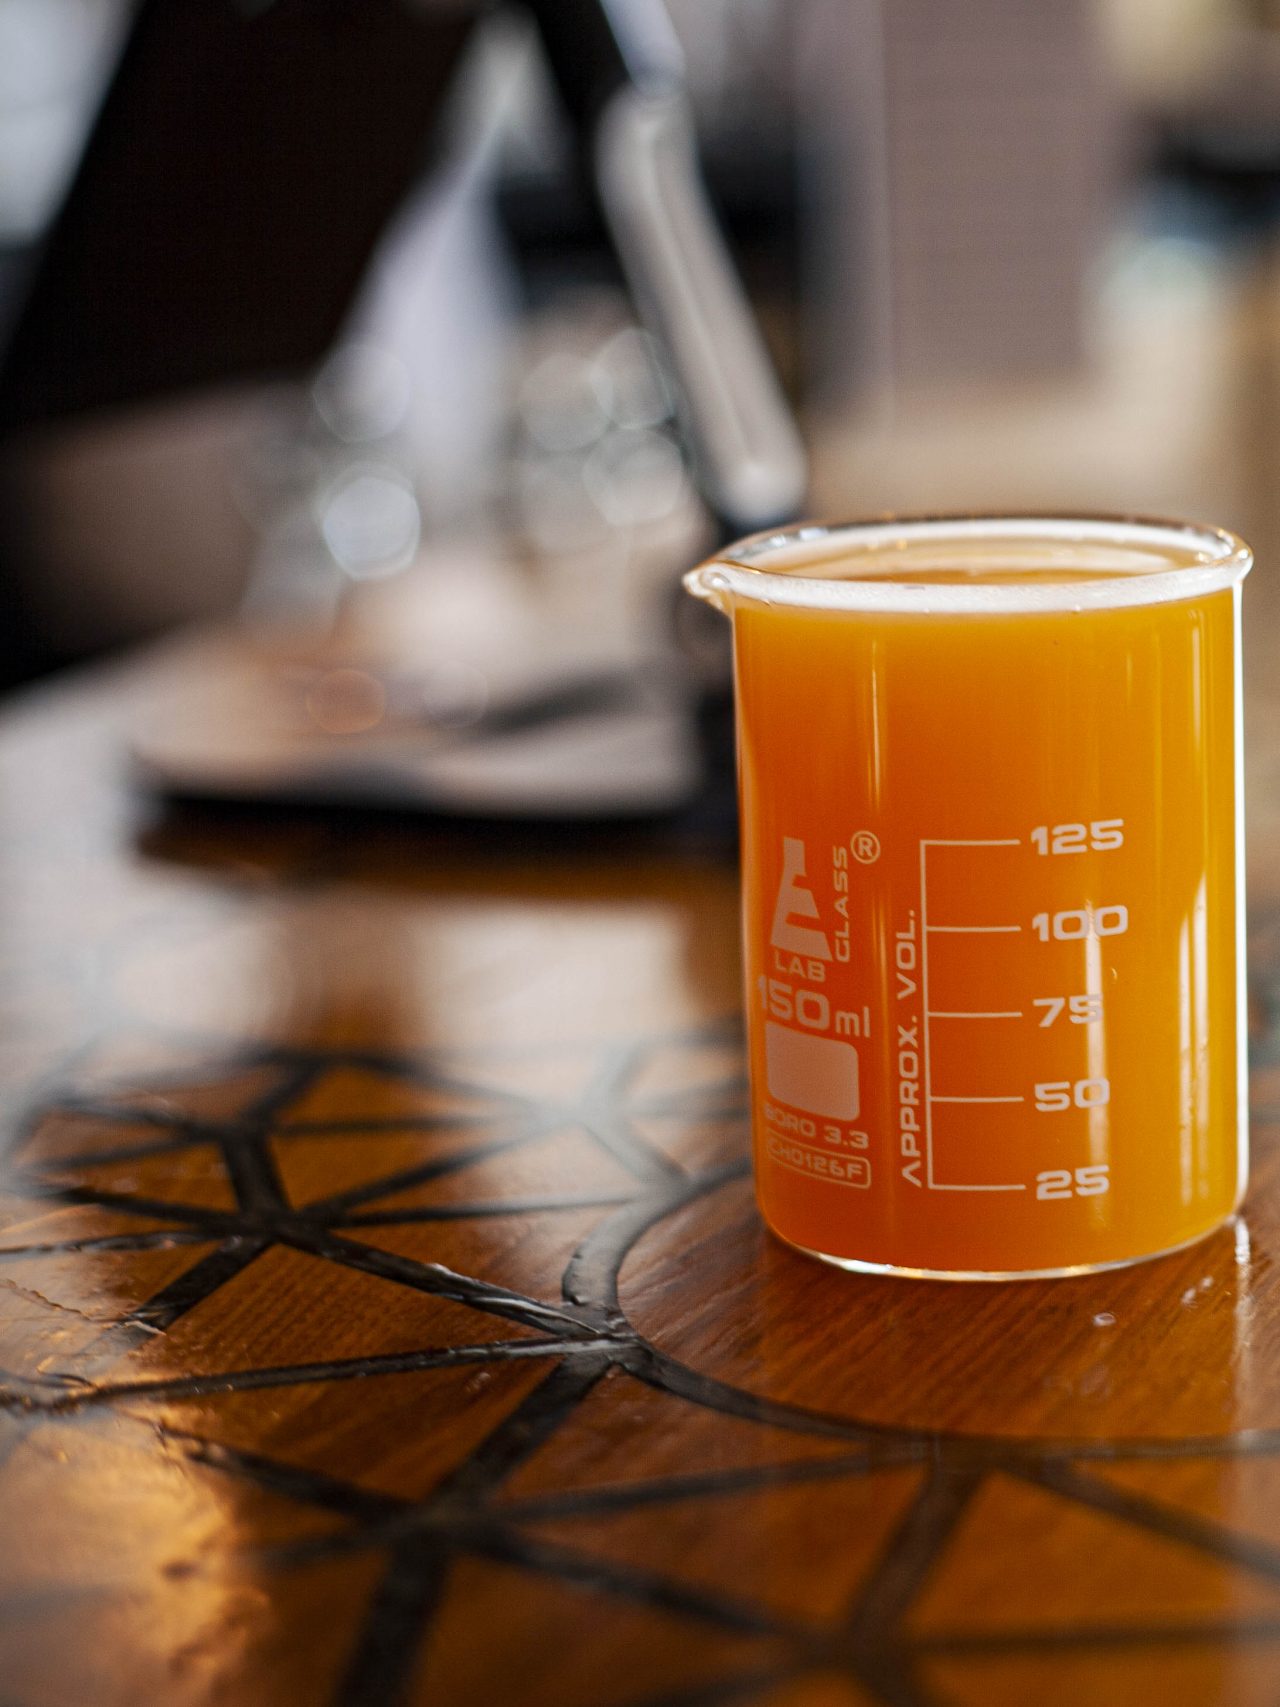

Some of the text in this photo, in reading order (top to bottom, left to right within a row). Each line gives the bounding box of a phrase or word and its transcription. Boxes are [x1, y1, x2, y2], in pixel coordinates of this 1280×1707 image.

[1030, 819, 1125, 856] 125
[833, 846, 851, 963] GLASS
[1032, 904, 1129, 942] 100
[775, 950, 826, 983] LAB
[1033, 995, 1104, 1028] 75
[895, 909, 922, 1189] APPROX. VOL.
[1034, 1078, 1111, 1112] 50
[824, 1125, 870, 1150] 3.3
[1036, 1165, 1110, 1201] 25
